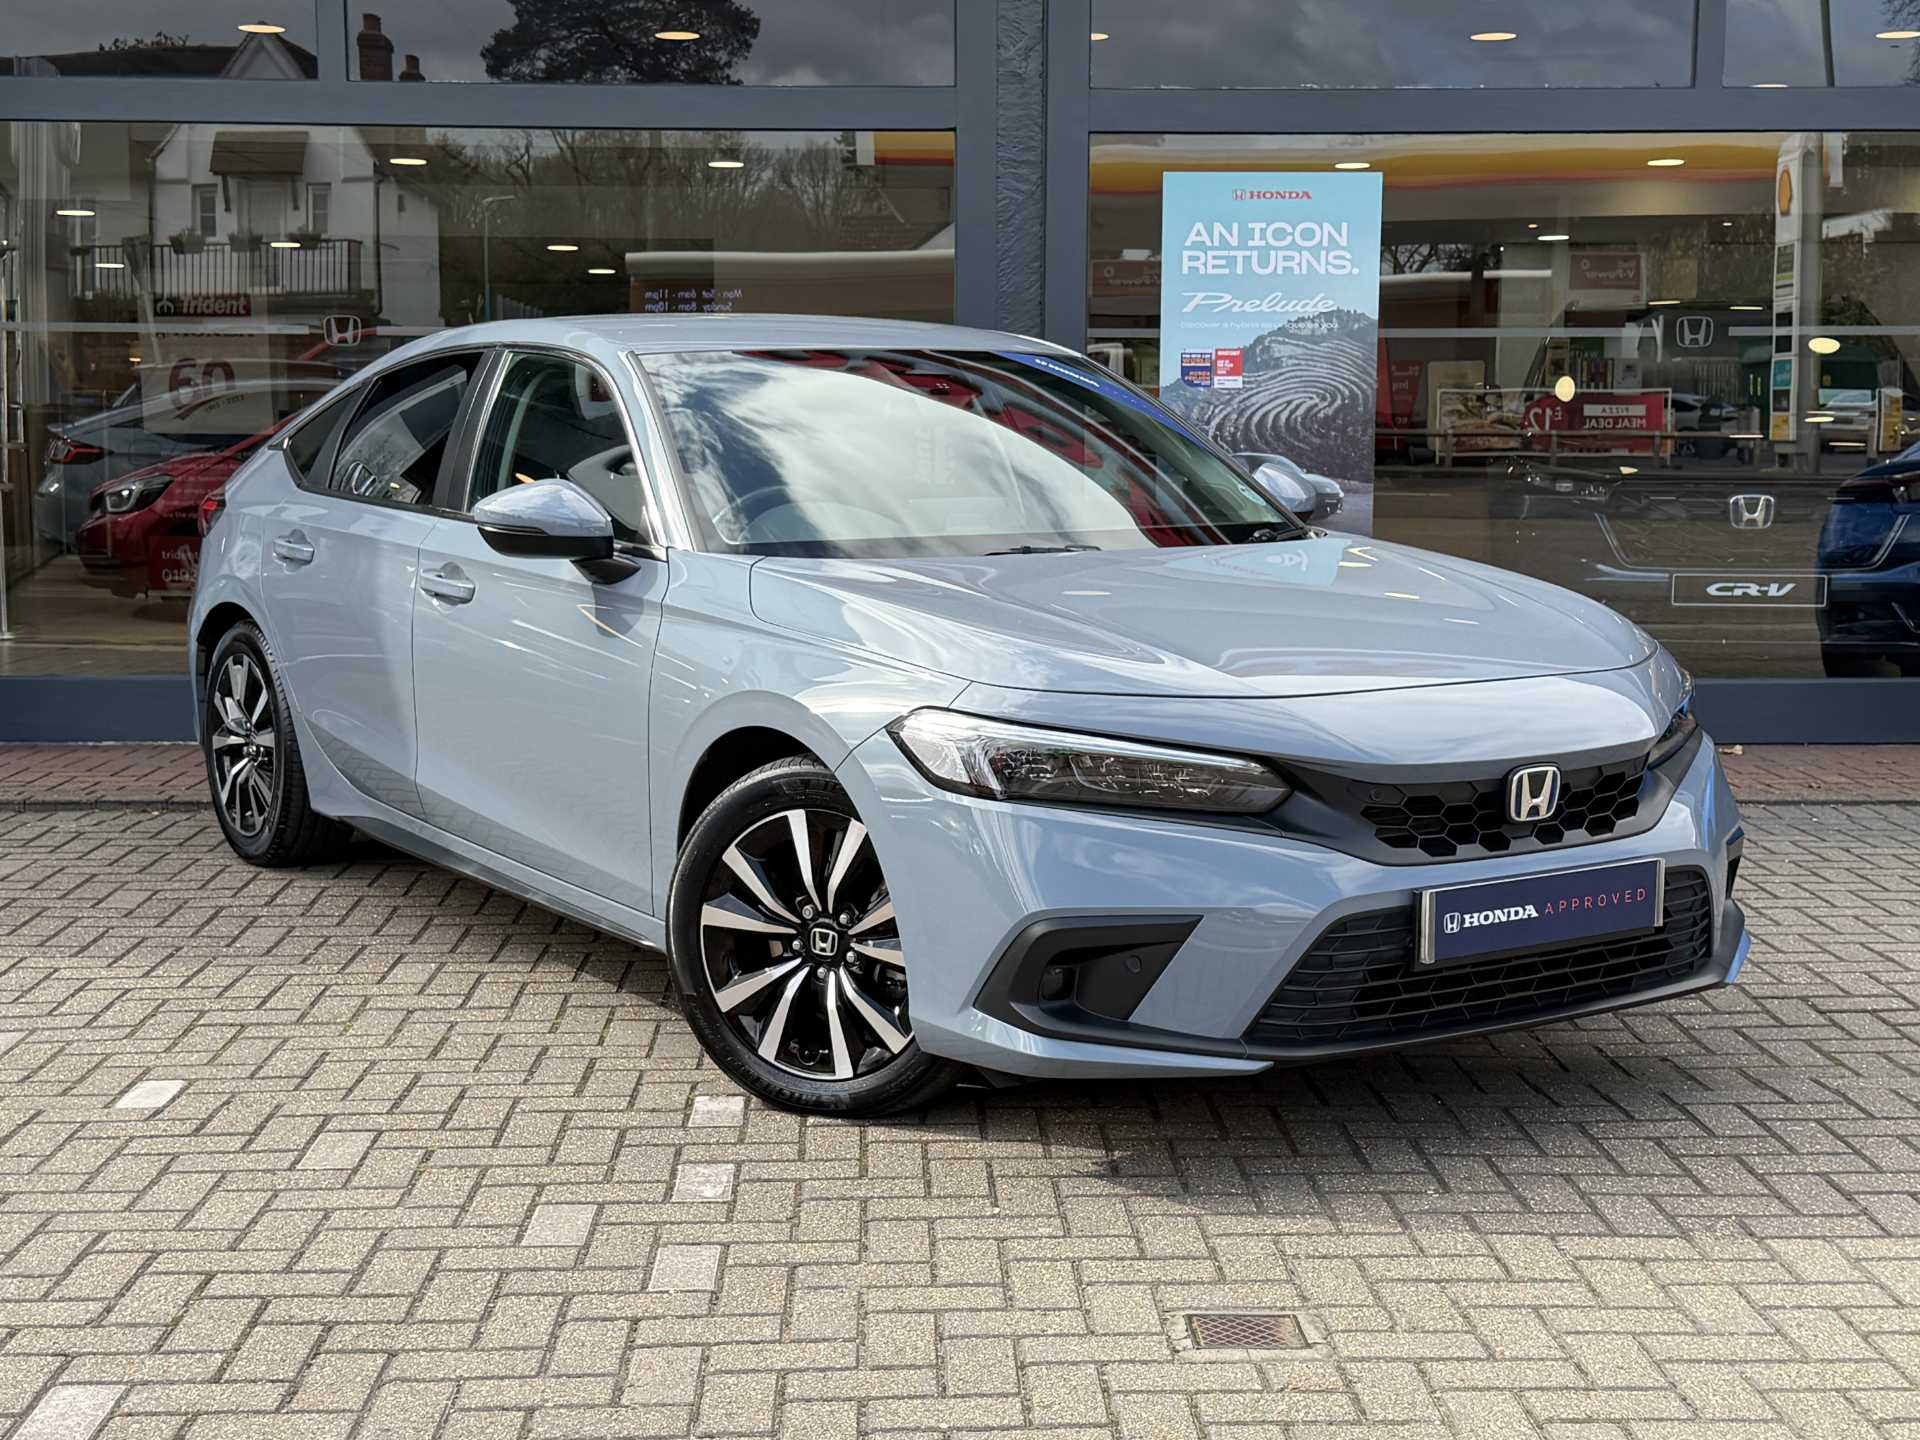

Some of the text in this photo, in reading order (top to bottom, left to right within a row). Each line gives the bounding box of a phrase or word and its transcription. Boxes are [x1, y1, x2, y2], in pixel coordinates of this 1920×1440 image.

[1249, 190, 1313, 200] HONDA
[1184, 221, 1349, 247] AN ICON
[1181, 249, 1361, 276] RETURNS.
[181, 295, 248, 315] Trident
[1181, 291, 1338, 313] Prelude
[1462, 887, 1647, 928] HONDA APPROVED
